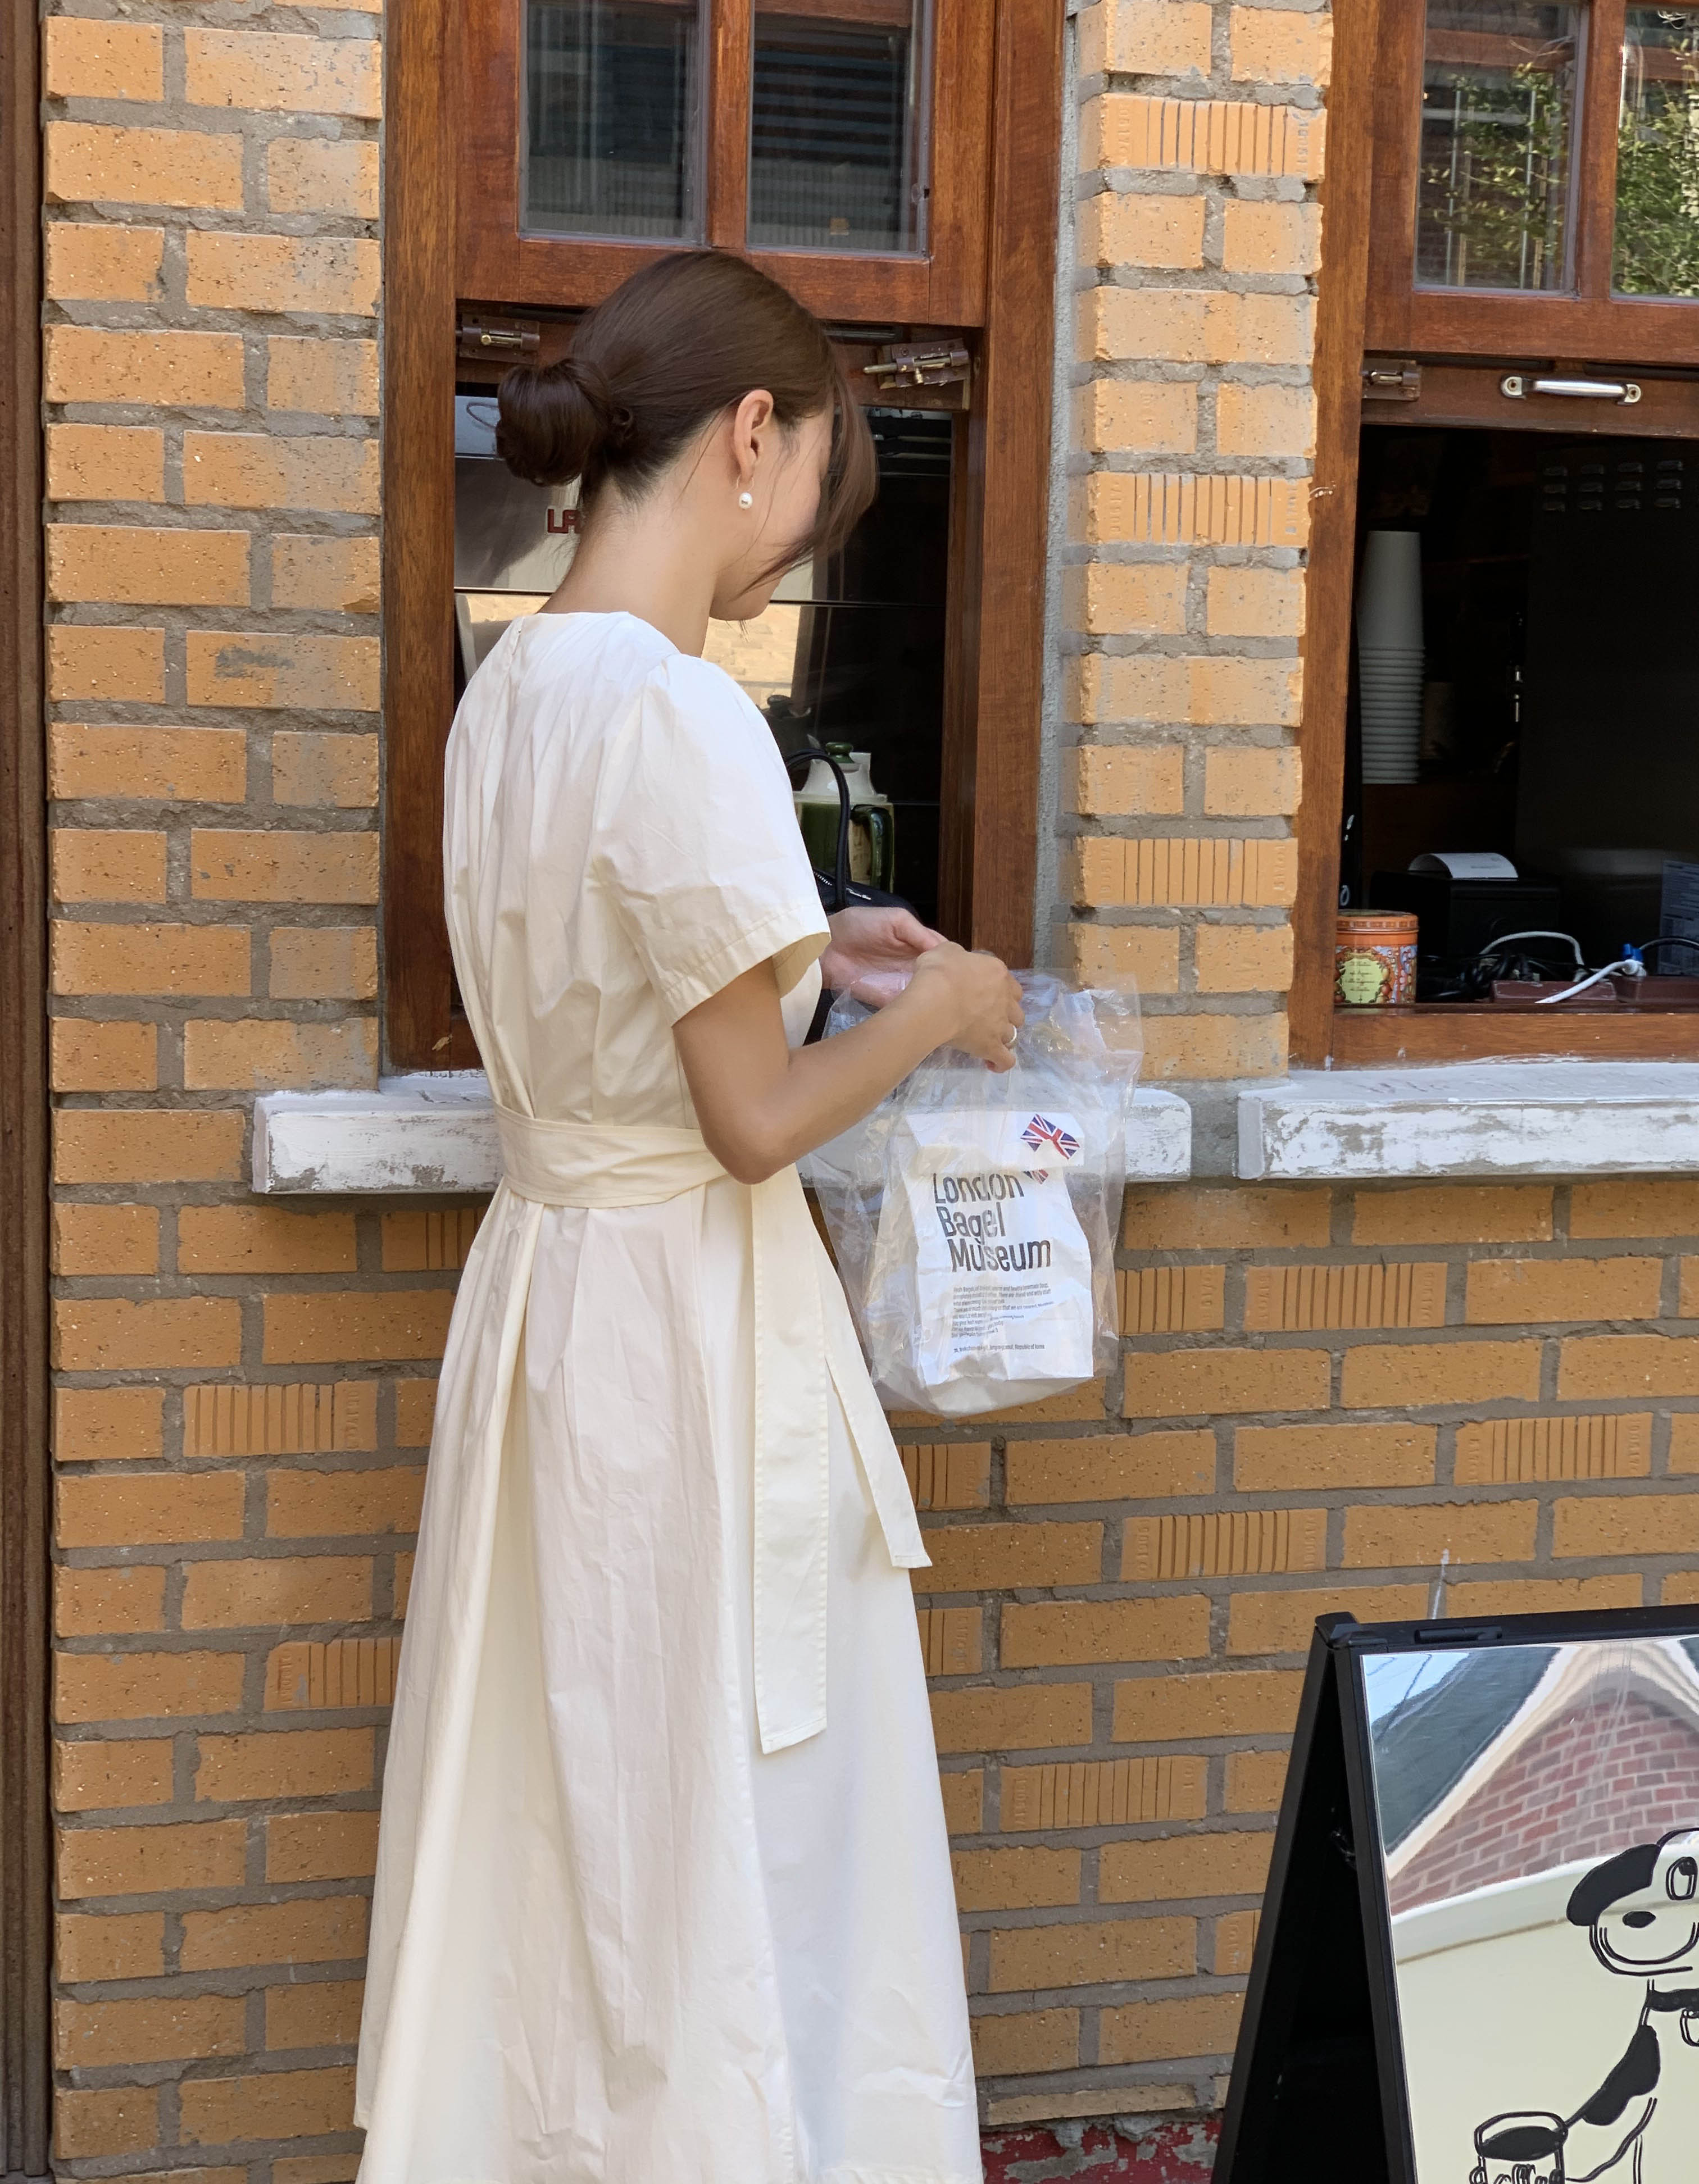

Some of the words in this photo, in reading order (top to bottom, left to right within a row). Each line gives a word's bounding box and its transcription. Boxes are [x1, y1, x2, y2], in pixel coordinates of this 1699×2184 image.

[933, 1172, 1024, 1203] London
[936, 1202, 1006, 1245] Bagel
[947, 1238, 1051, 1272] Museum
